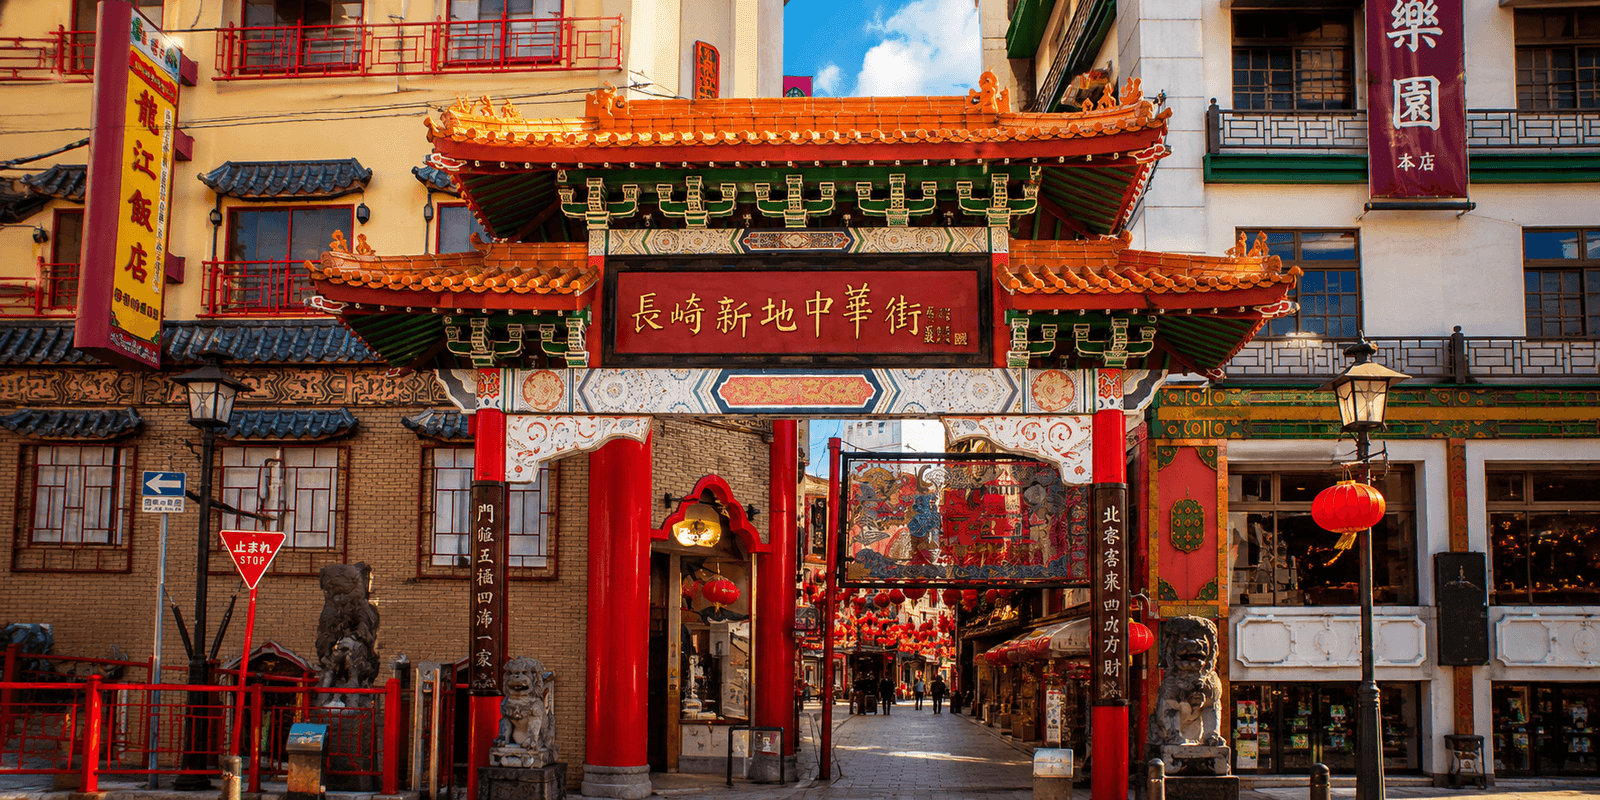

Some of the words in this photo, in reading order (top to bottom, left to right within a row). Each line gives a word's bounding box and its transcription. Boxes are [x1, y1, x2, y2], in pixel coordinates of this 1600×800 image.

[1386, 0, 1443, 131] 樂園
[1397, 152, 1436, 172] 本店
[125, 89, 160, 284] 龍江飯店
[631, 282, 922, 340] 長崎新地中華街
[233, 541, 273, 554] 止まれ
[240, 556, 265, 566] STOP
